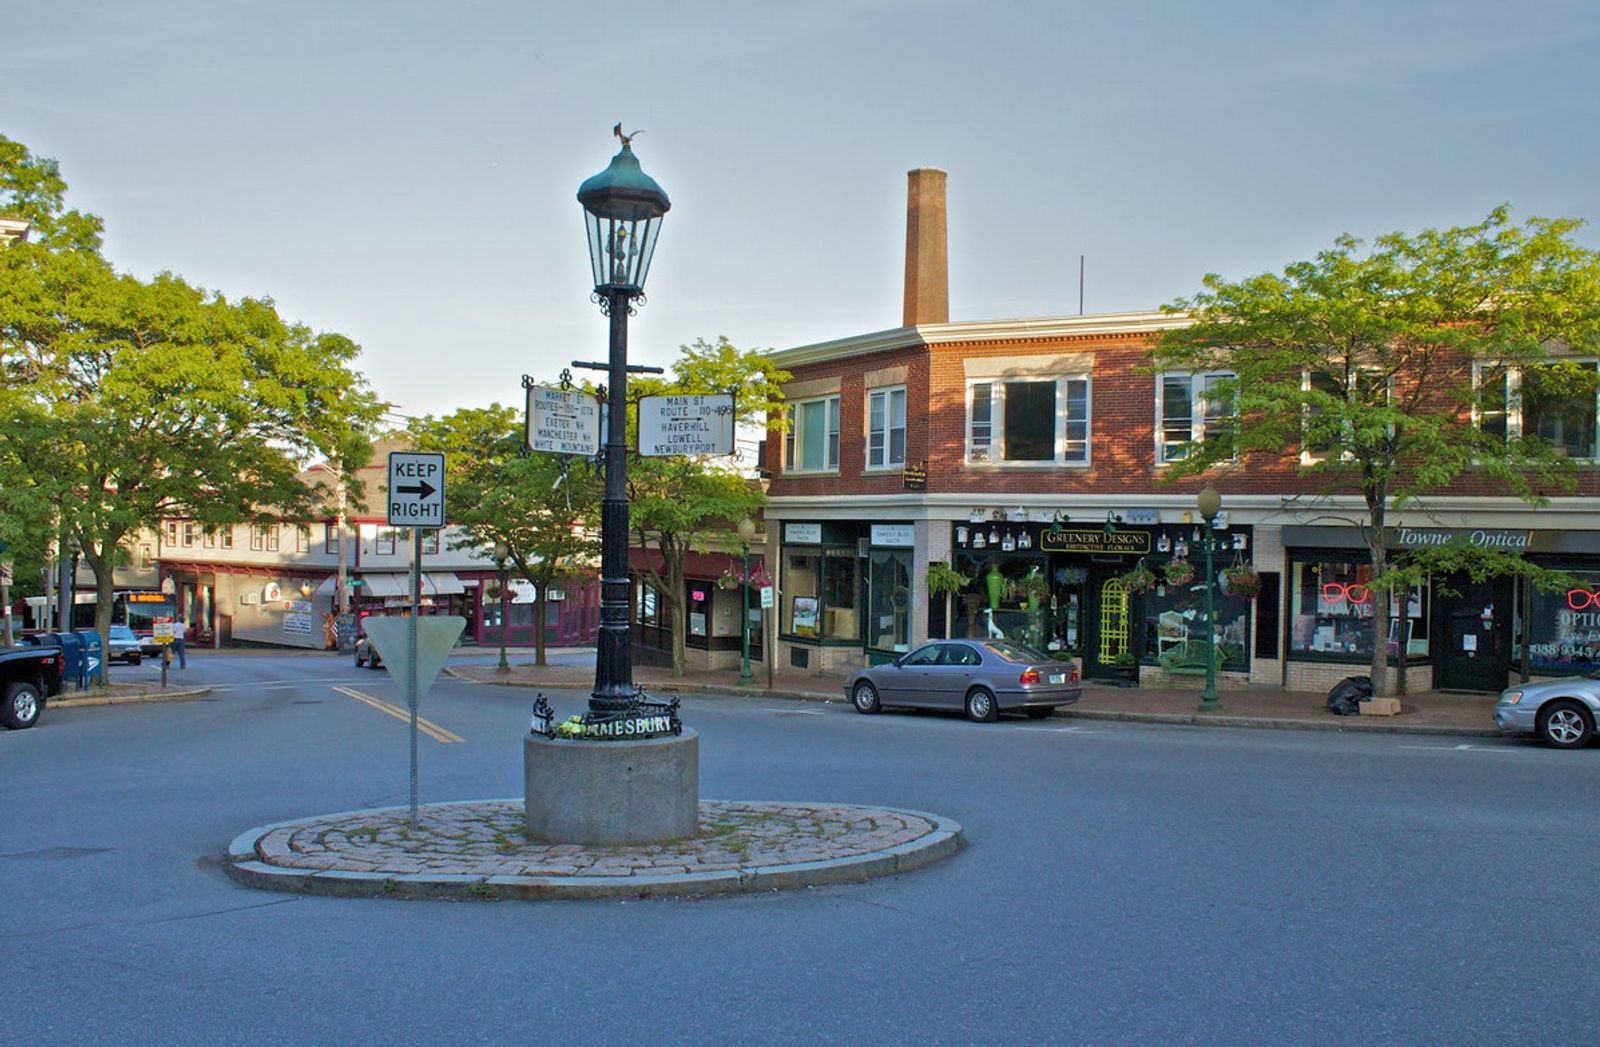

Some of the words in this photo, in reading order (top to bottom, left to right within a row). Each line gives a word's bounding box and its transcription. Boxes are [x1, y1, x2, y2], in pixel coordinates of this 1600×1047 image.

[545, 391, 571, 402] MARKET
[576, 392, 585, 404] ST
[666, 397, 688, 406] MAIN
[694, 396, 705, 405] ST
[660, 407, 688, 416] ROUTE
[545, 417, 570, 429] EXETER
[576, 421, 585, 430] NH
[661, 422, 710, 432] HAVERHILL
[537, 428, 578, 441] MANCHESTER
[583, 433, 592, 442] NH
[667, 434, 703, 444] LOWELL
[534, 440, 553, 450] WHITE
[561, 442, 594, 453] MOUNTAINS
[654, 443, 716, 454] NEWBURYPORT
[395, 463, 437, 477] KEEP
[391, 503, 440, 517] RIGHT
[1398, 528, 1452, 545] Towne
[1470, 530, 1534, 549] Optical
